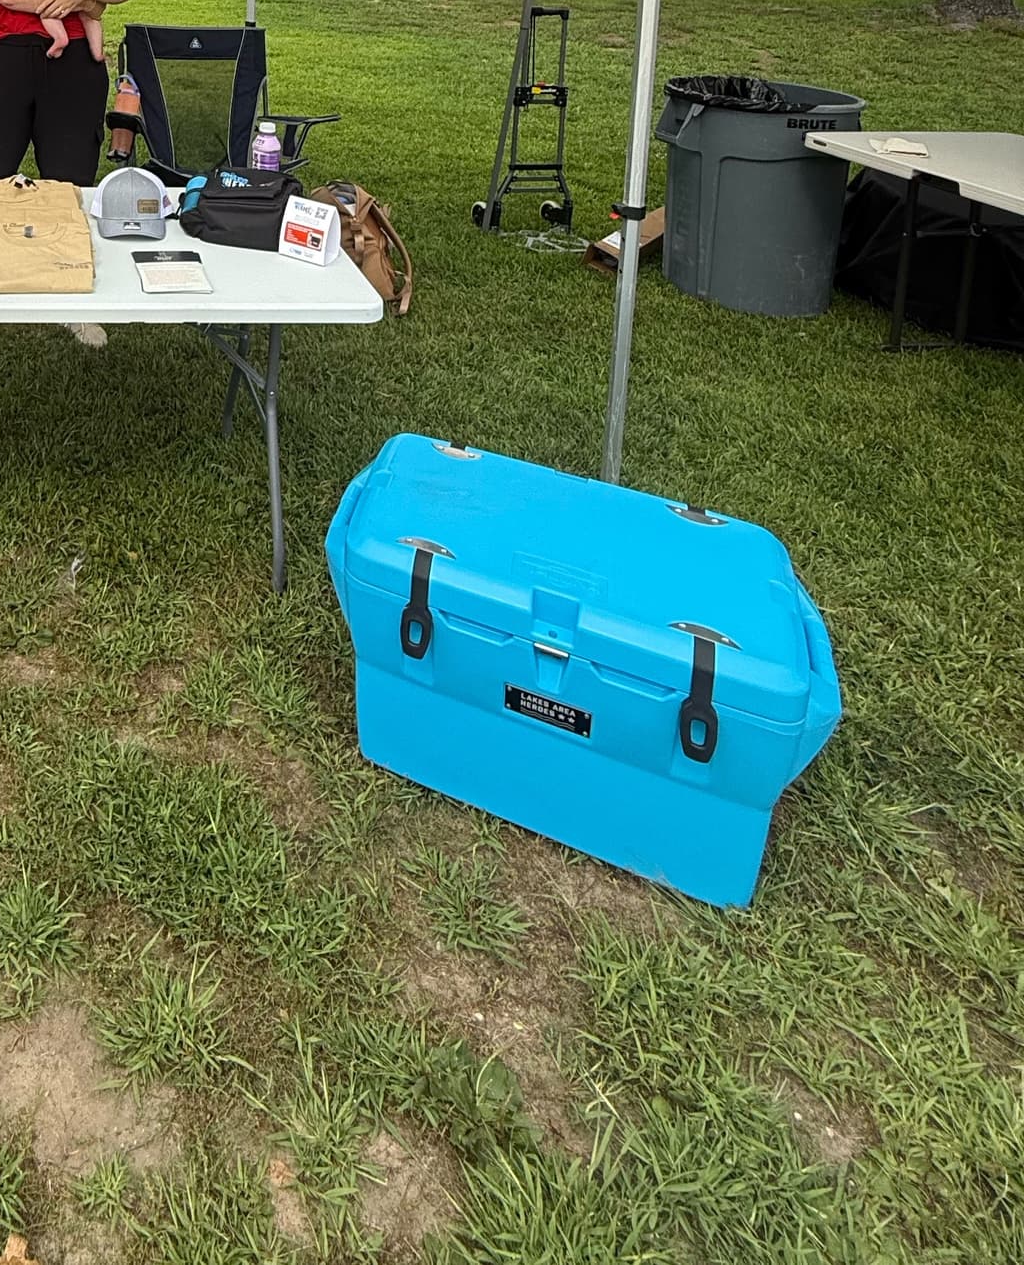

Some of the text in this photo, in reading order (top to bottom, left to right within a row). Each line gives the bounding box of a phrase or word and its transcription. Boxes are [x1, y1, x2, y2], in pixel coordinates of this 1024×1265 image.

[786, 117, 838, 131] BRUTE
[520, 692, 576, 718] LAKES AREA
[520, 699, 556, 718] HEROES
